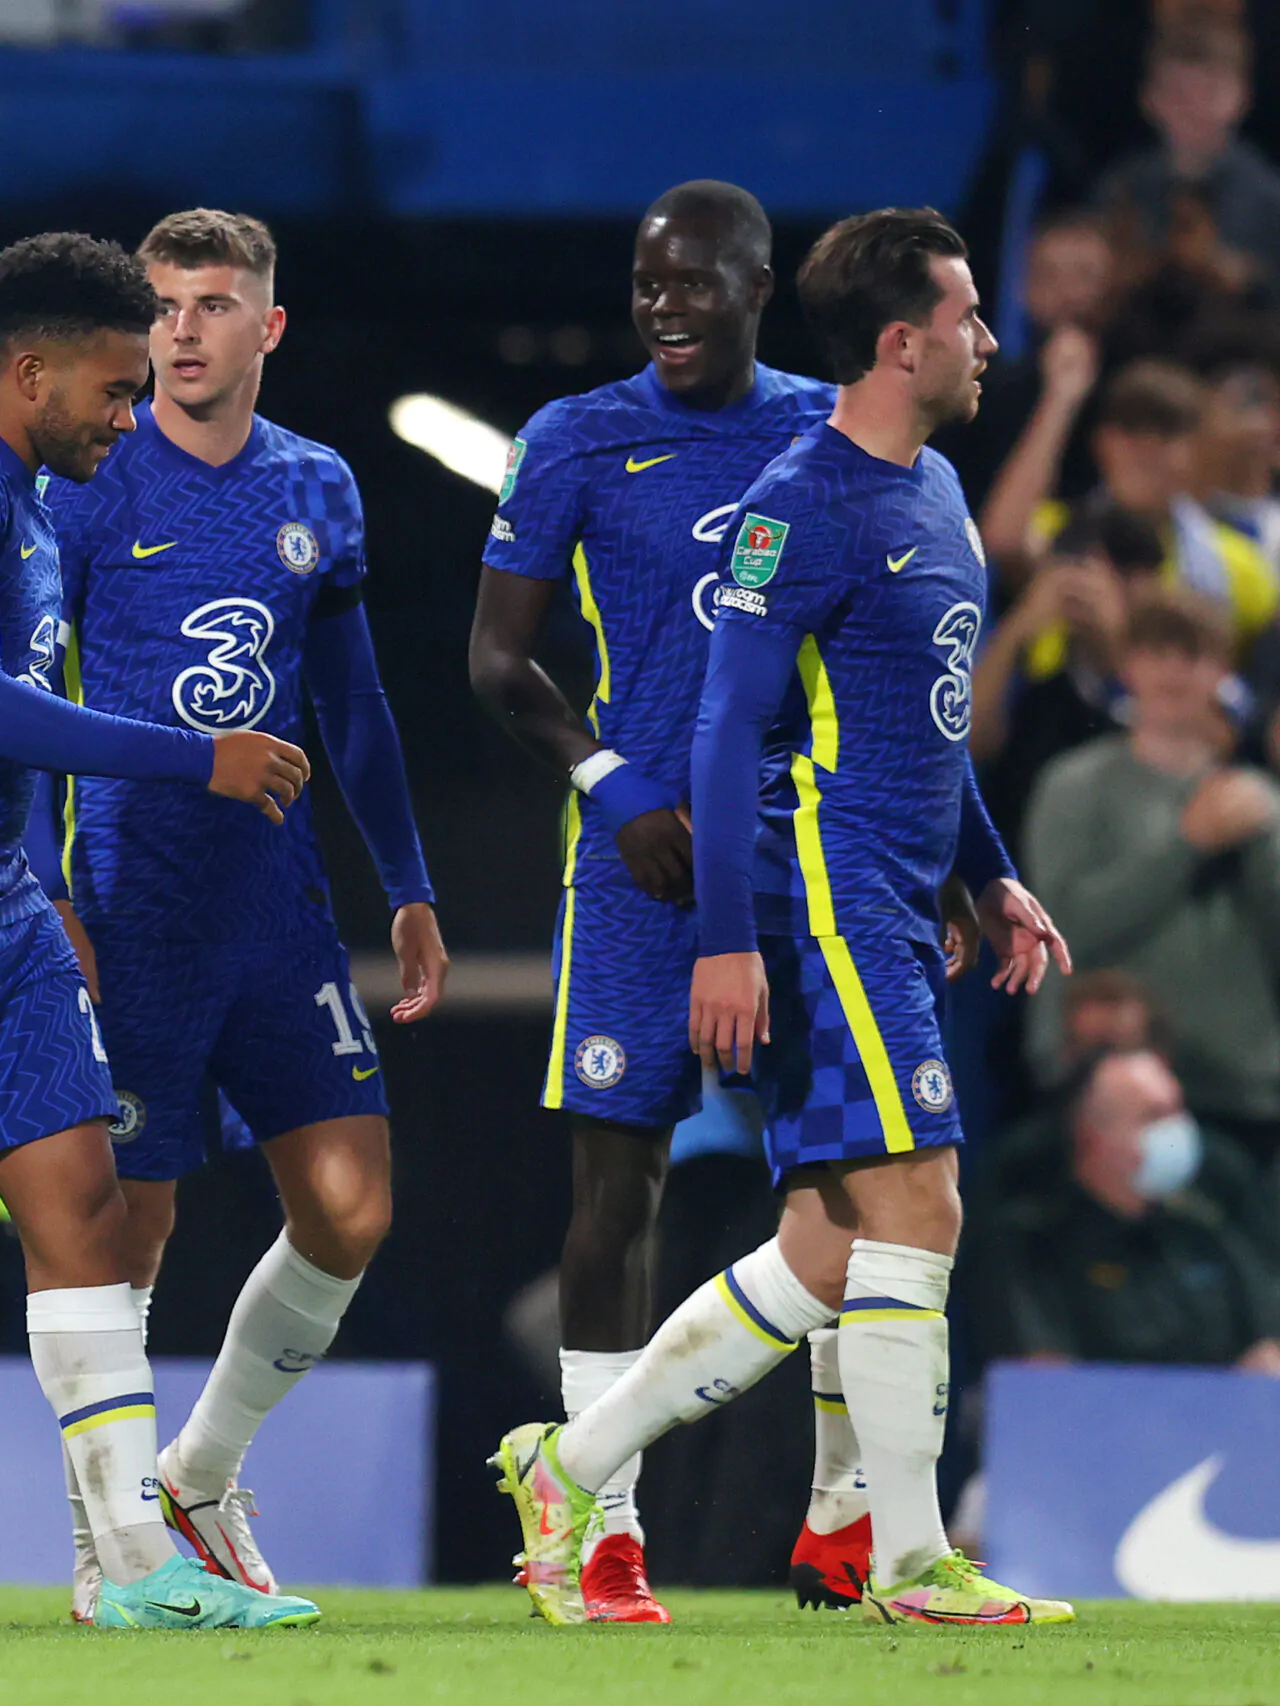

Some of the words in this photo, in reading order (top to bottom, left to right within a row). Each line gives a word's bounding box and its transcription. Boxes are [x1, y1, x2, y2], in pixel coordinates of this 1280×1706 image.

[743, 557, 763, 567] Cup
[172, 597, 276, 736] 3
[930, 601, 981, 742] 3
